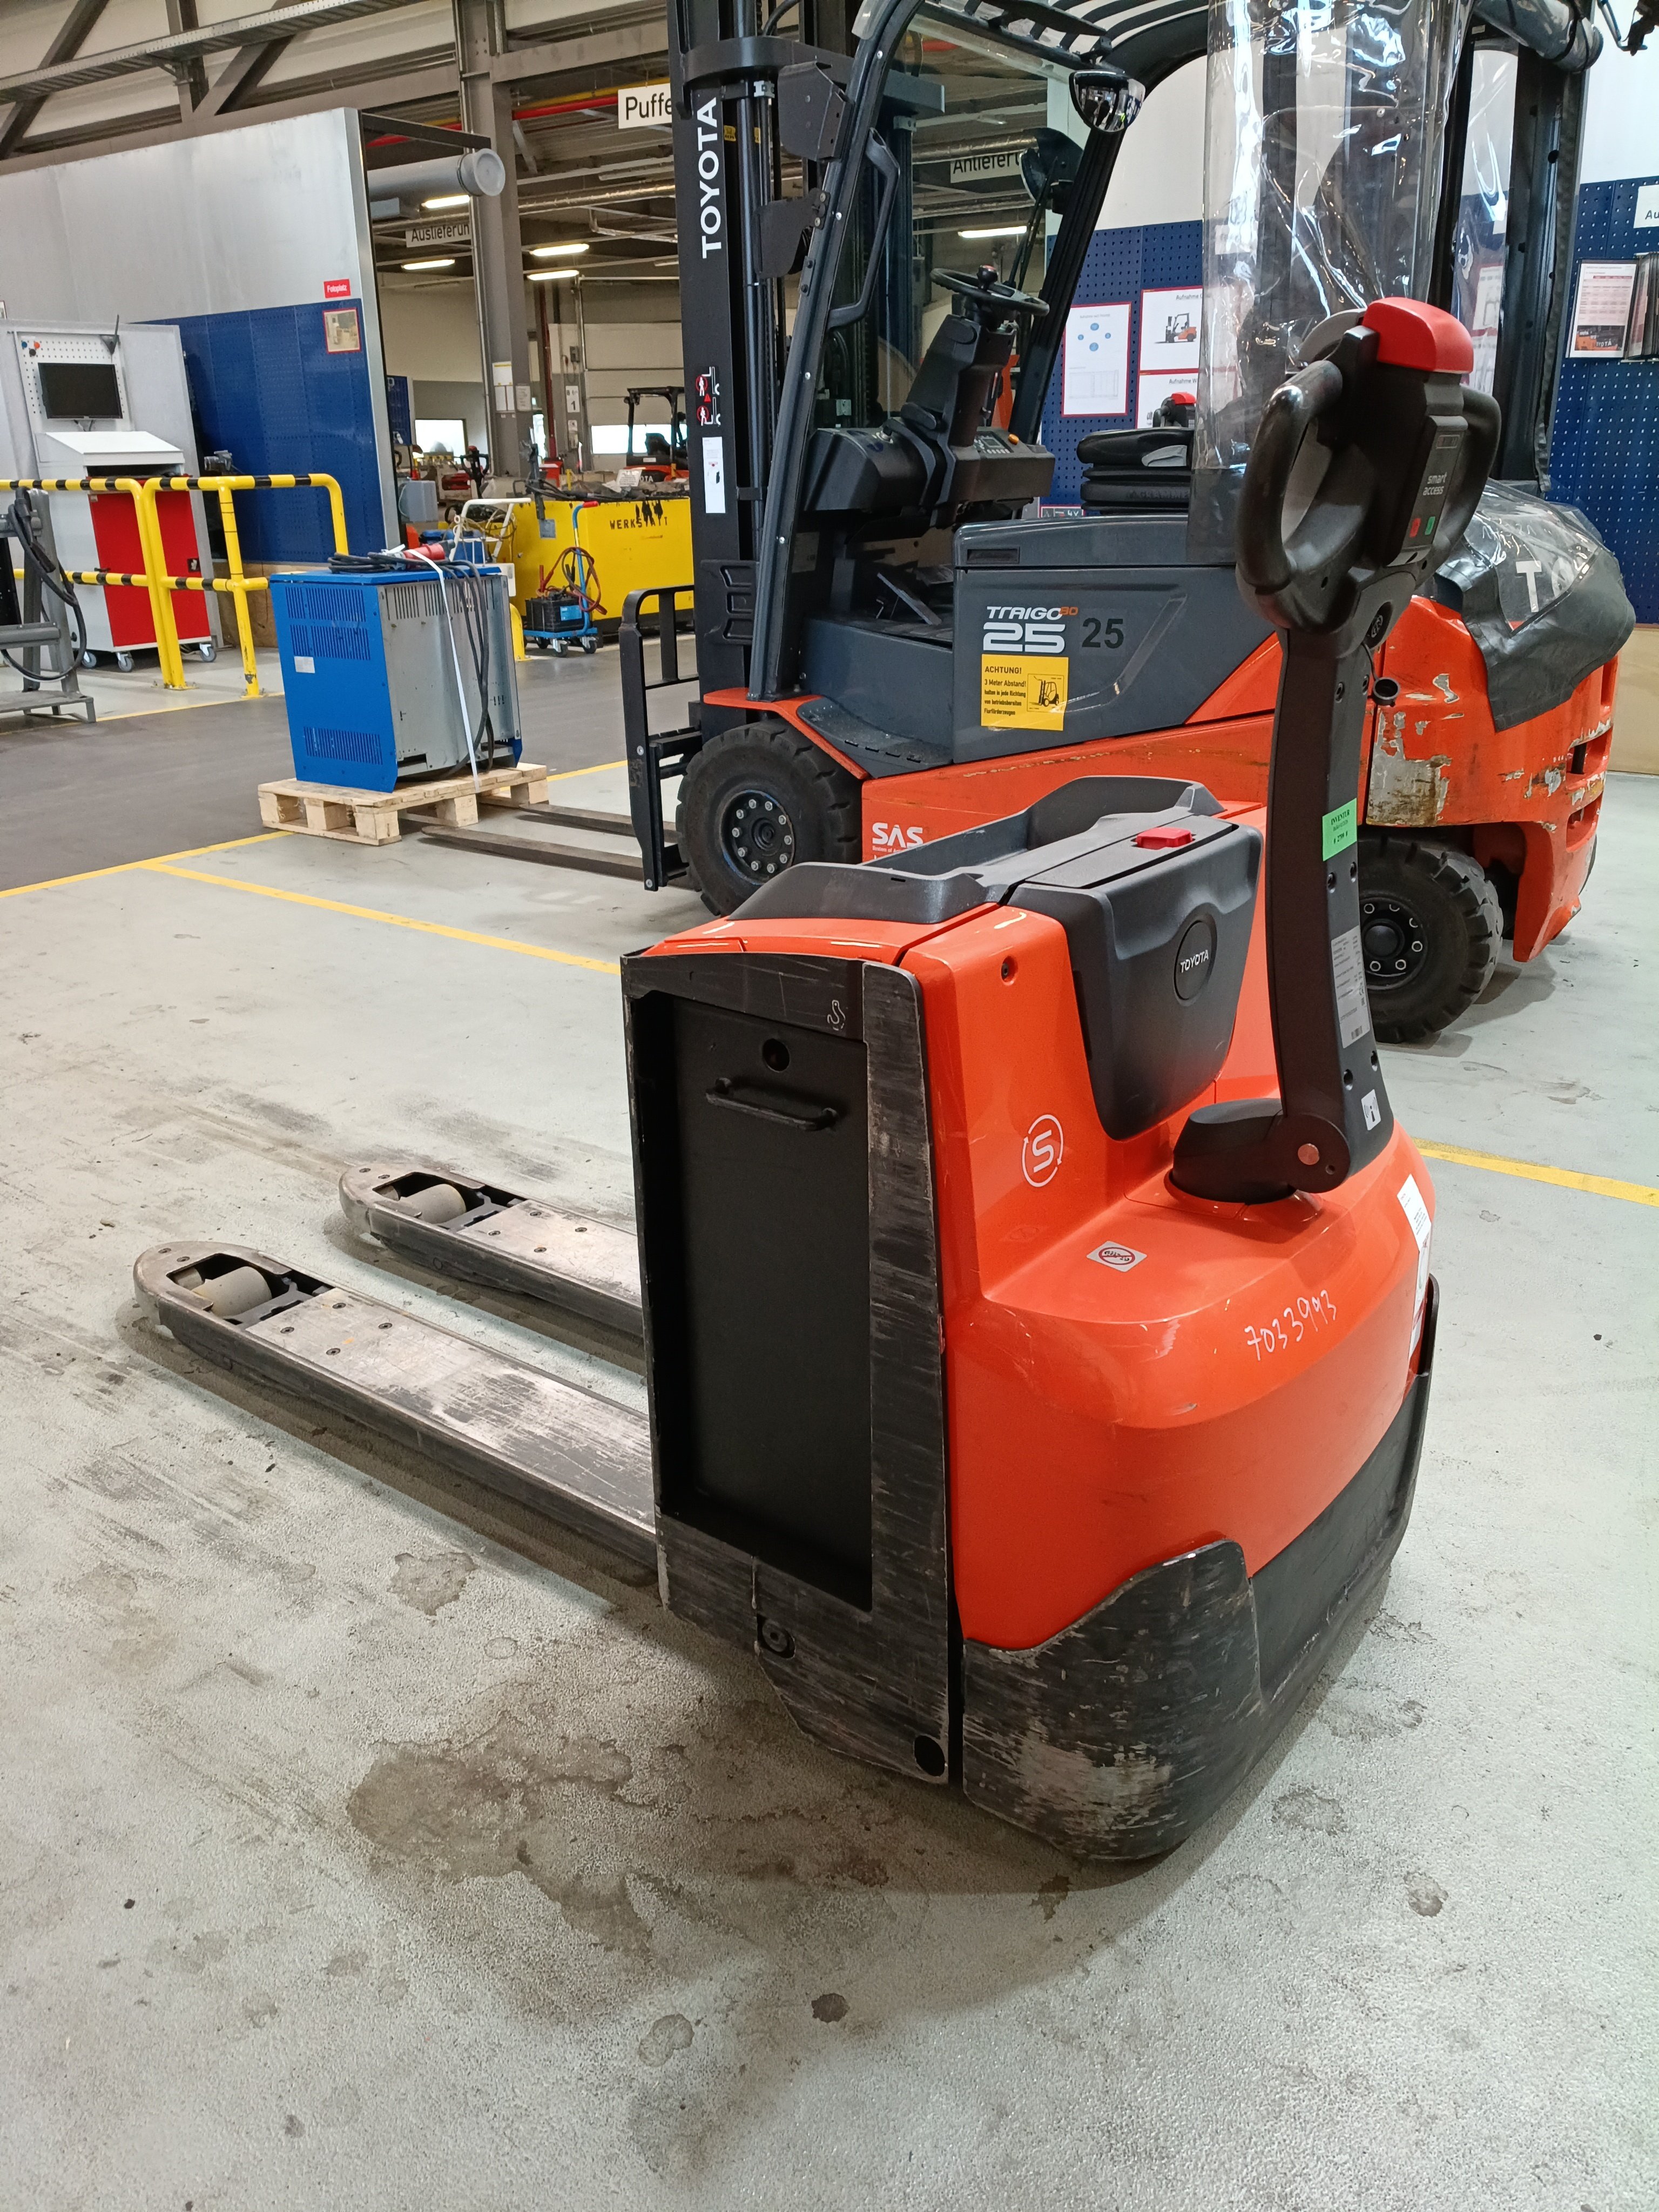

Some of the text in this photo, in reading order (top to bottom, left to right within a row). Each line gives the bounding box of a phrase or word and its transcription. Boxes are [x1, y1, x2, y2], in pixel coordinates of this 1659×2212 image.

[697, 97, 722, 259] TOYOTA
[327, 284, 347, 294] Fotoplatz
[1427, 471, 1447, 484] smart
[1422, 486, 1445, 496] access
[987, 606, 1062, 620] TRAIGO
[983, 622, 1065, 653] 25
[1082, 618, 1124, 649] 25
[984, 666, 1022, 674] ACHTUNG!
[1331, 809, 1350, 825] INVENTUR
[872, 822, 923, 848] SAS
[1180, 949, 1209, 973] TOYOTA
[1244, 1289, 1337, 1361] 7033993
